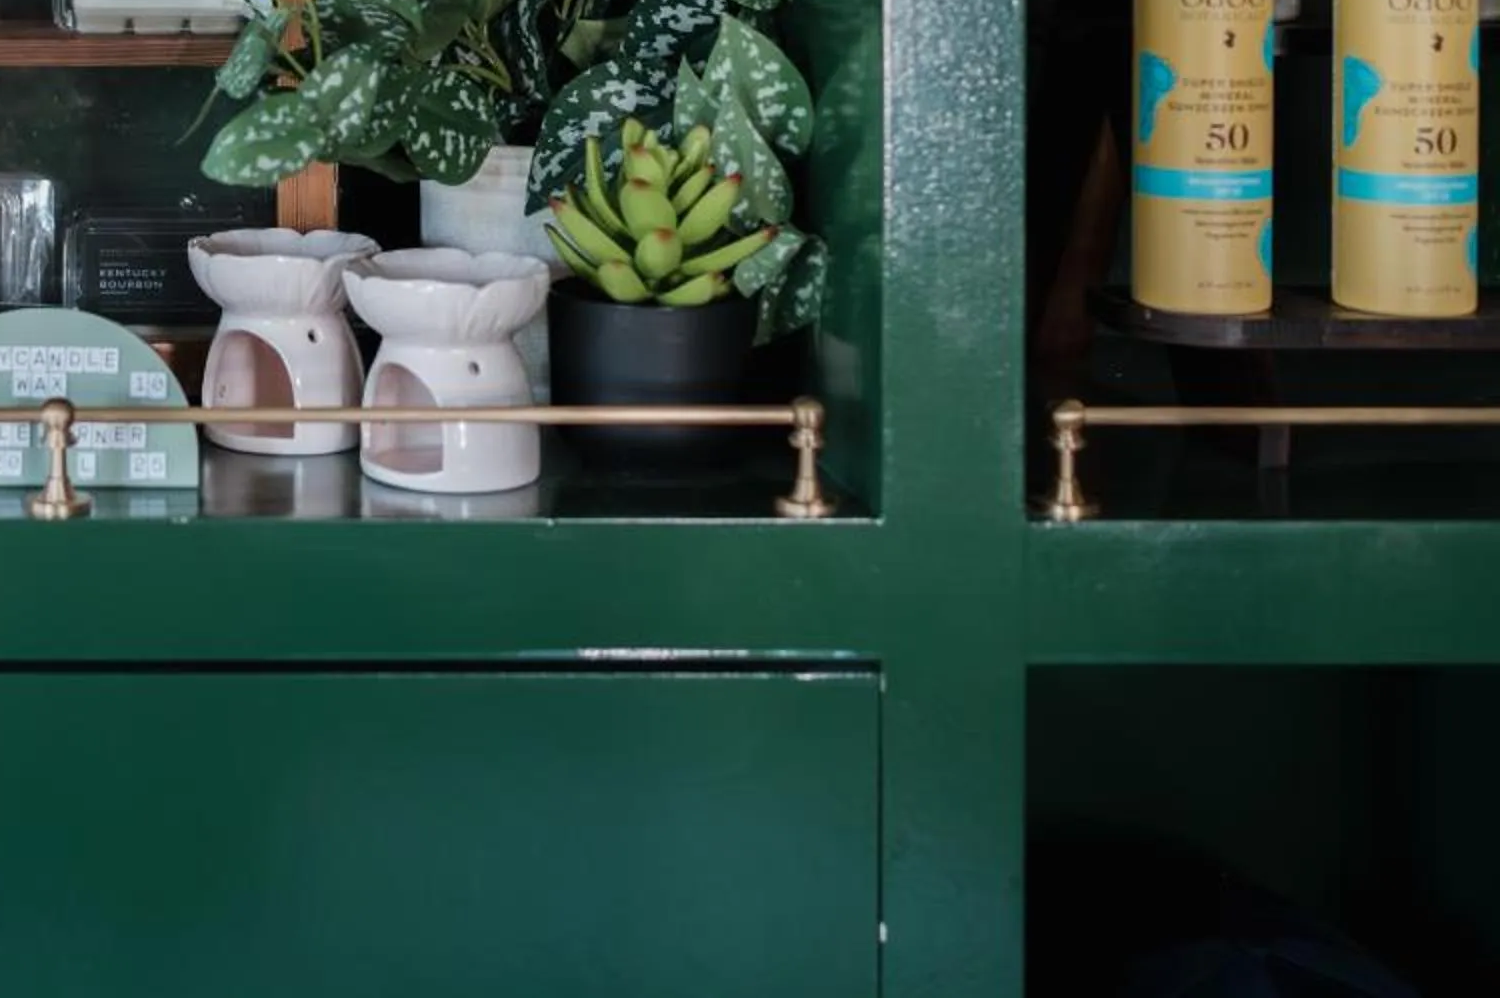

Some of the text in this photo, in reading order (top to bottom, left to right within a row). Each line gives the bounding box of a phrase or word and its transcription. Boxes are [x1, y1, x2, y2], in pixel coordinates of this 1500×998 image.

[1205, 123, 1249, 151] 50
[1414, 127, 1458, 154] 50
[99, 268, 167, 278] KENTUCKY
[99, 279, 164, 290] BOURBON
[16, 374, 166, 393] WAX 10
